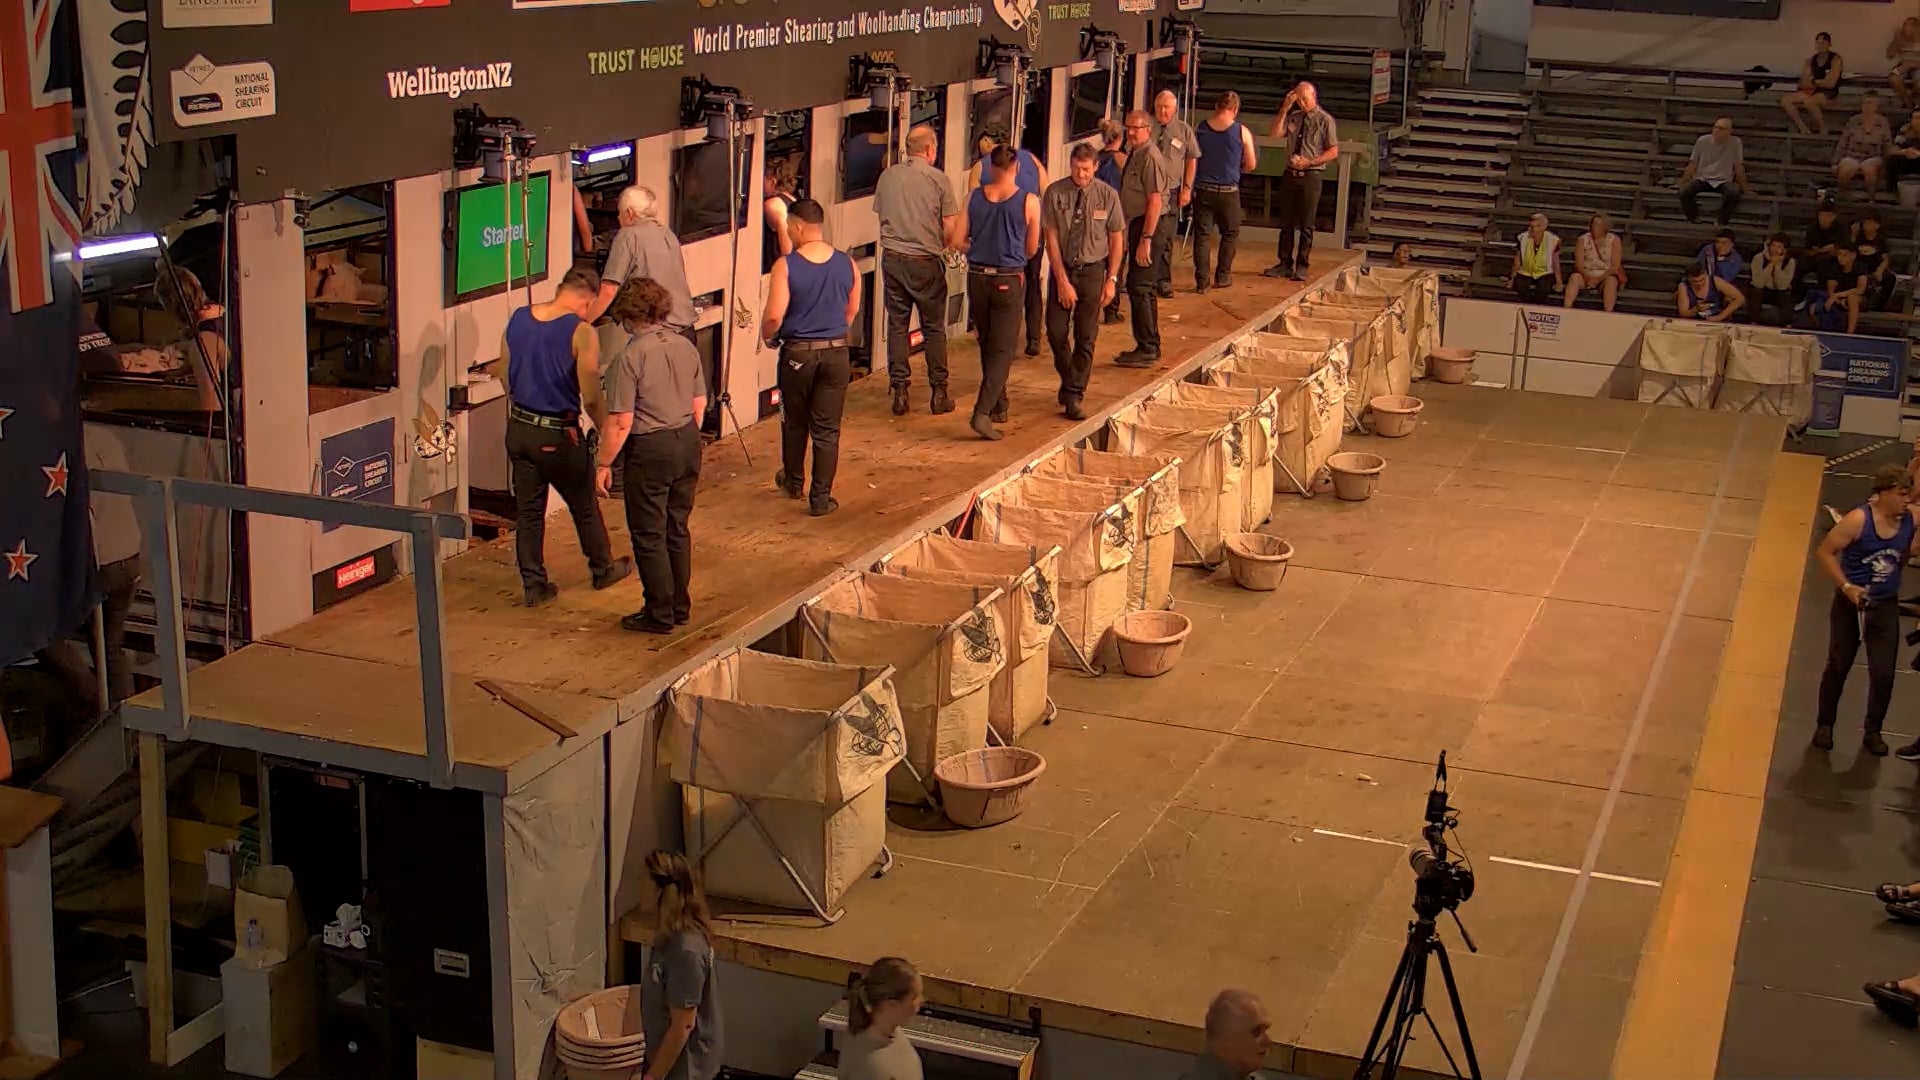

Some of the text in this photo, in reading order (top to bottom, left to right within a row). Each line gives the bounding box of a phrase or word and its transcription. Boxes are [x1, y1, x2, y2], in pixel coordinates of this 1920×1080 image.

[1048, 4, 1069, 20] TRUST
[694, 2, 982, 54] World Premier Shearing and Woolhandling Championship
[588, 44, 684, 75] TRUST HOUSE
[234, 72, 270, 84] NATIONAL
[387, 61, 512, 99] WellingtonNZ
[234, 84, 270, 97] SHEARING
[235, 97, 263, 109] CIRCUIT
[1528, 313, 1560, 323] NOTICE
[1849, 359, 1889, 369] NATIONAL
[1849, 367, 1889, 377] SHEARING
[1848, 375, 1880, 384] CIRCUIT
